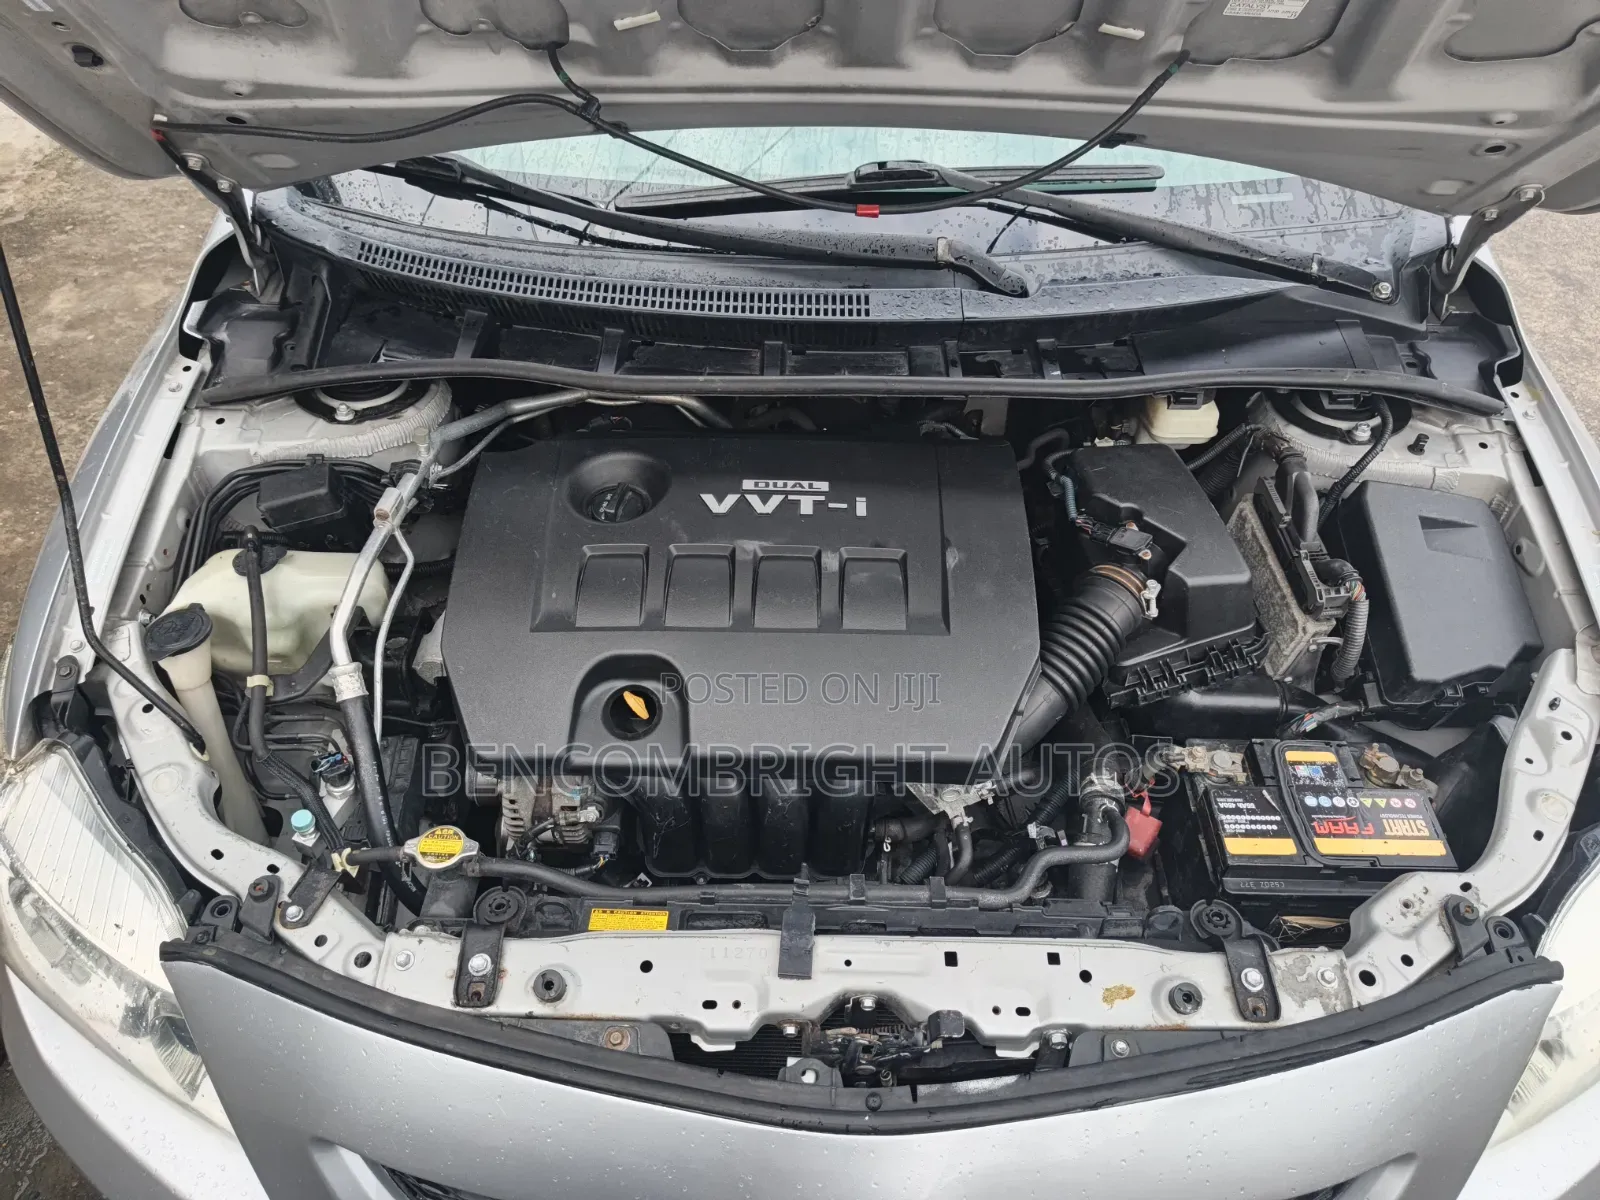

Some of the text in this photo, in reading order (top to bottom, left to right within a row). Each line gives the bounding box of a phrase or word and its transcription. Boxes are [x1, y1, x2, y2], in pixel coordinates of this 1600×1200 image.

[753, 480, 822, 490] DUAL
[699, 493, 867, 517] VVT-i
[1311, 820, 1375, 835] FAAM
[1381, 818, 1430, 837] START
